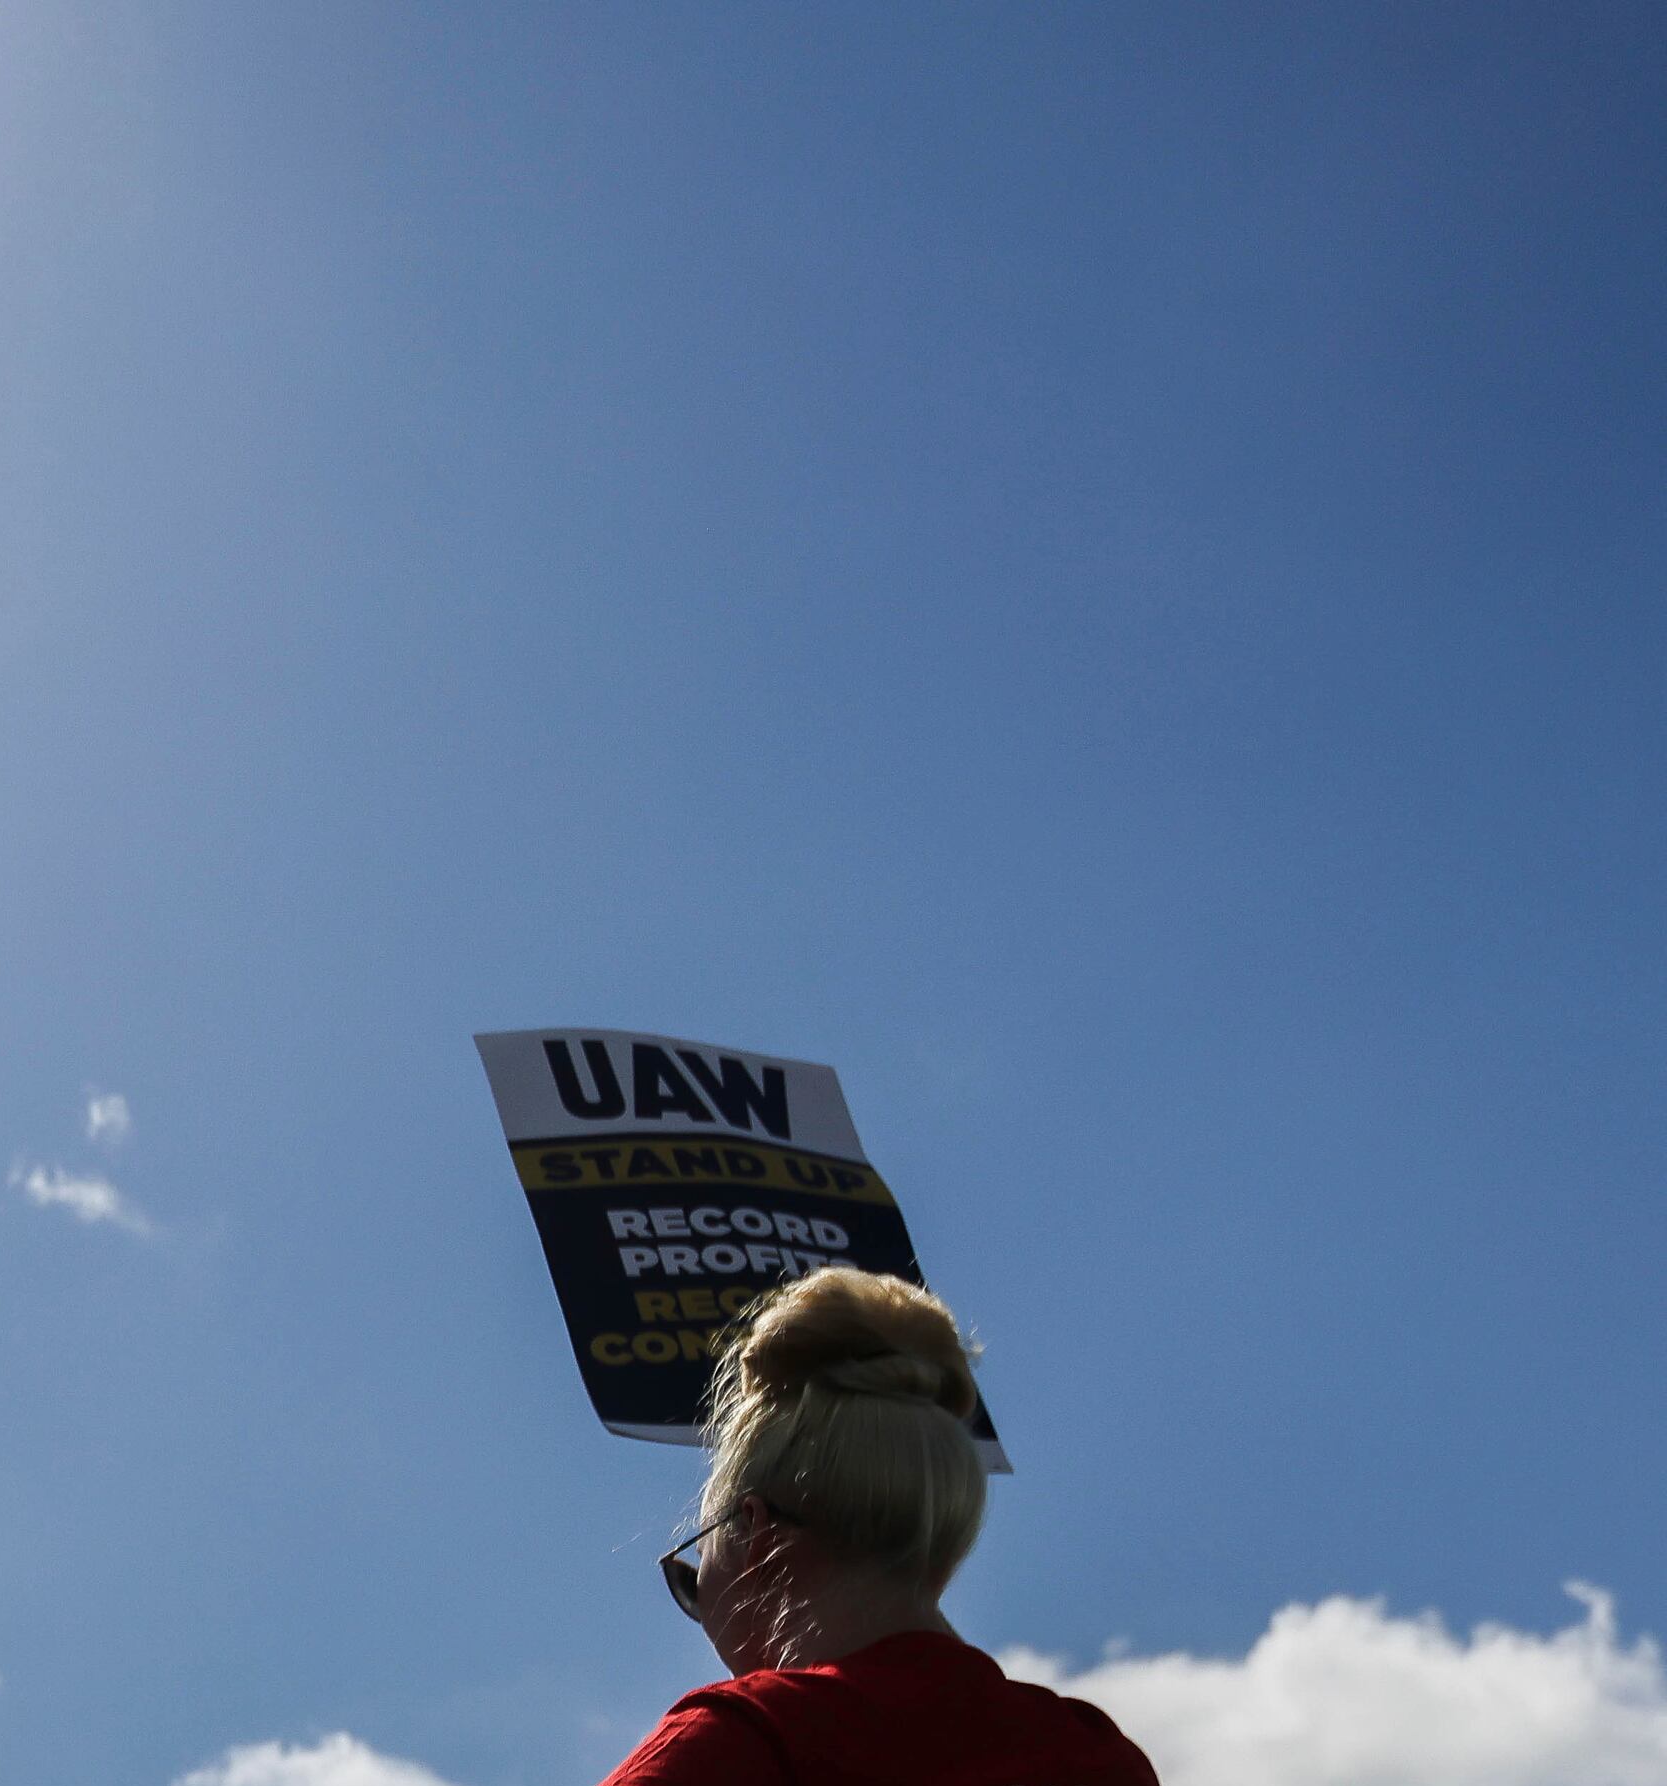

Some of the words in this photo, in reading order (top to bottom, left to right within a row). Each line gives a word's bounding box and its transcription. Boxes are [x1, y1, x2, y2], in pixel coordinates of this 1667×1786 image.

[543, 1039, 792, 1140] UAW
[539, 1147, 766, 1184] STAND
[784, 1163, 866, 1194] UP
[607, 1206, 850, 1250] RECORD
[619, 1243, 858, 1277] PROFIT
